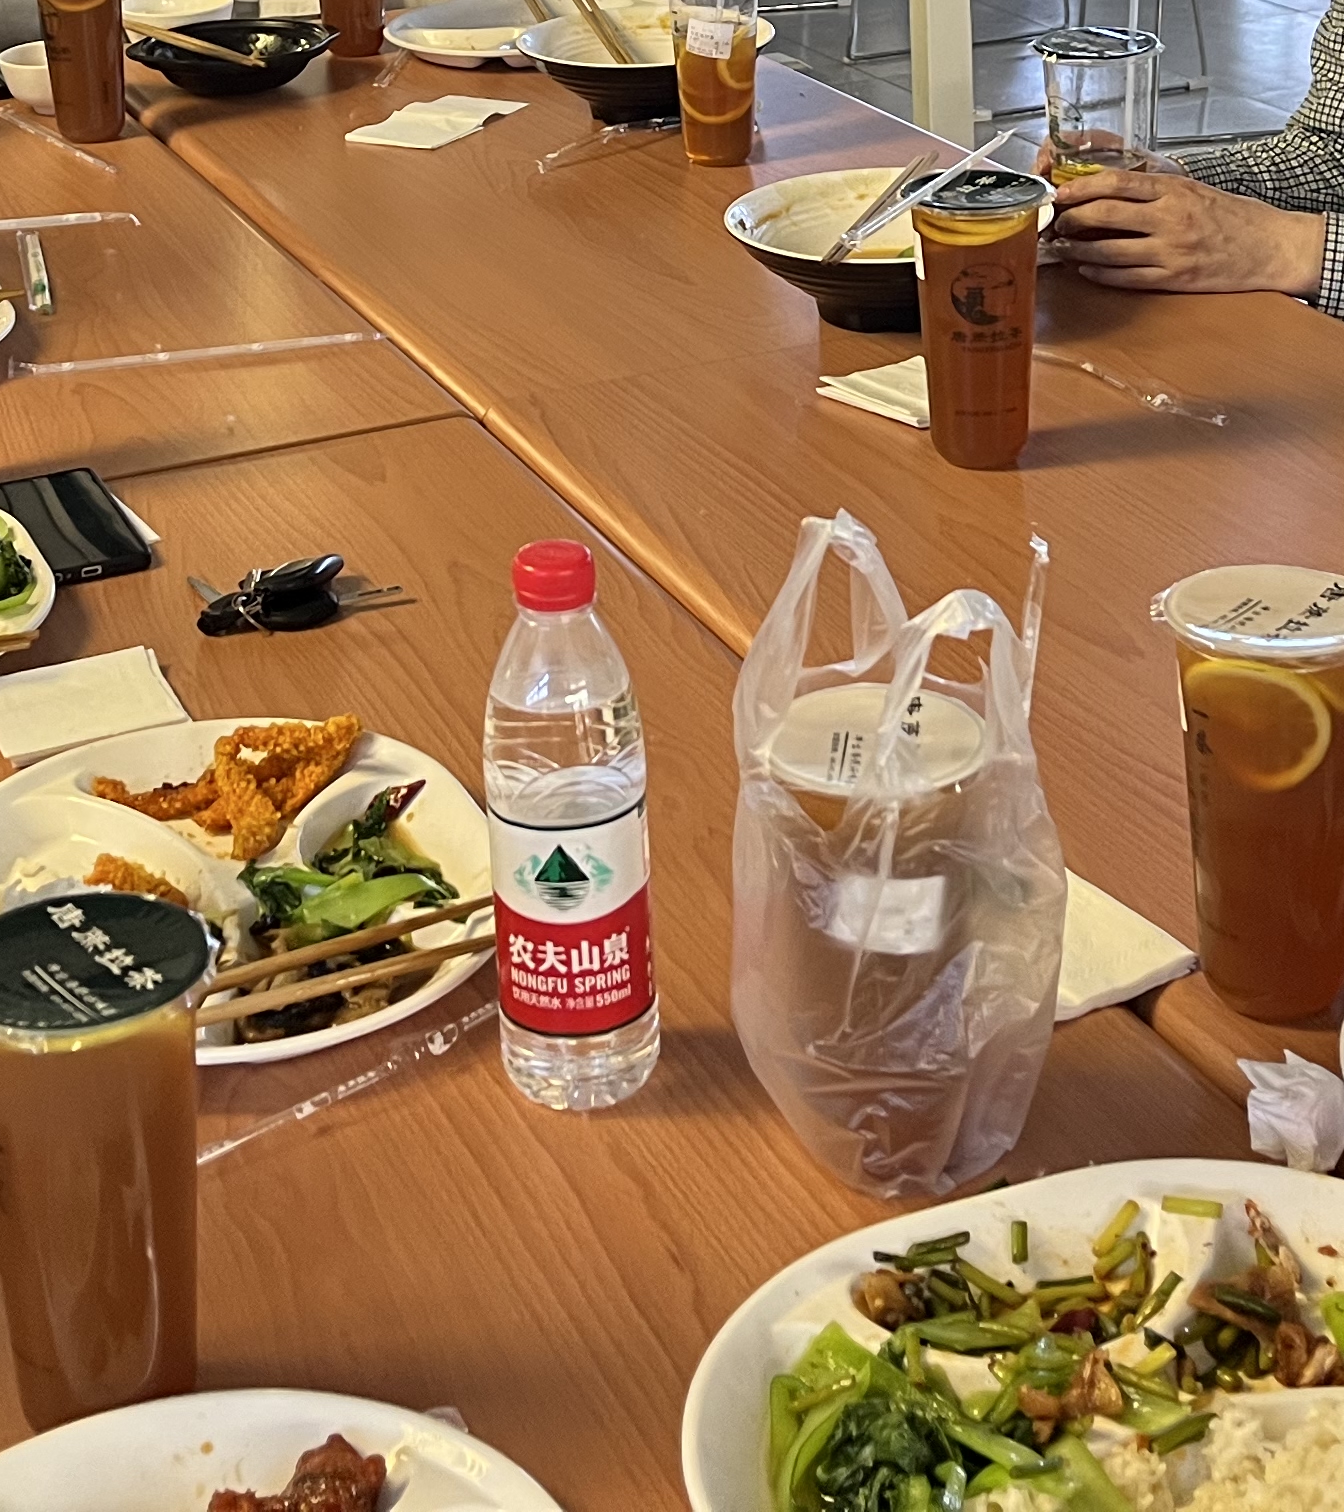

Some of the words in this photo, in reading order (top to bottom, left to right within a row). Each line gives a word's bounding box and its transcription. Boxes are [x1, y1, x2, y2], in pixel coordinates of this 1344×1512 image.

[508, 931, 630, 975] 农夫山泉
[510, 964, 568, 994] NONGFU
[573, 963, 631, 994] SPRING
